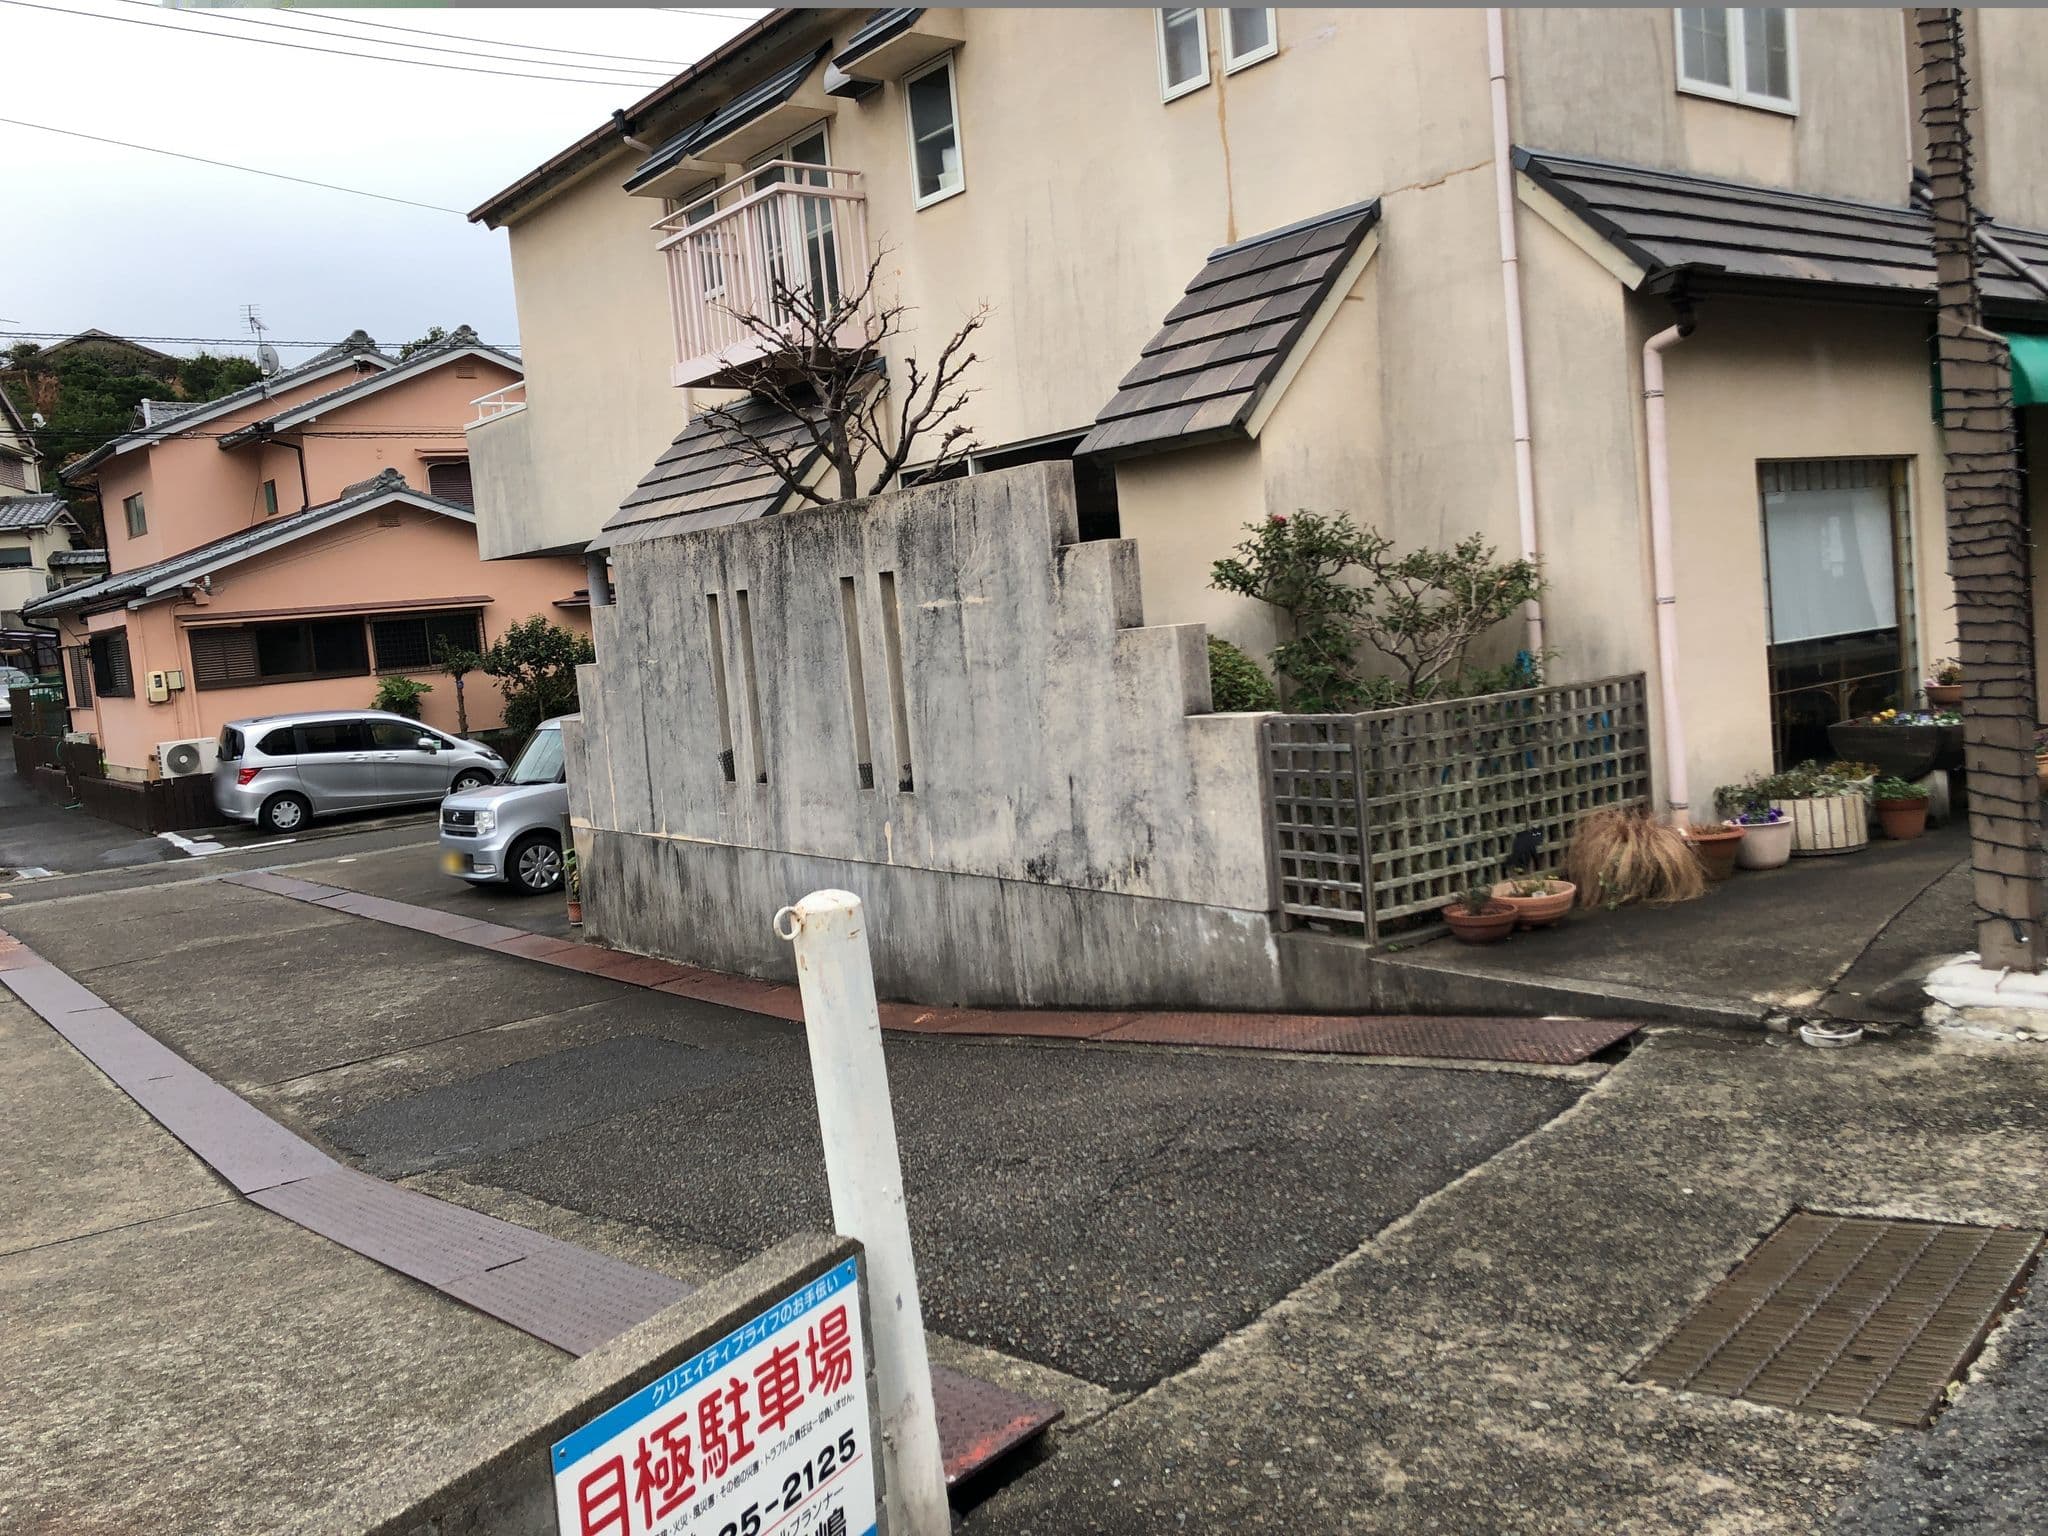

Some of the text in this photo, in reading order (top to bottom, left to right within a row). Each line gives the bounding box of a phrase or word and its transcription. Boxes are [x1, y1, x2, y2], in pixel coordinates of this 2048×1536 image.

[578, 1304, 852, 1536] 月極駐車場
